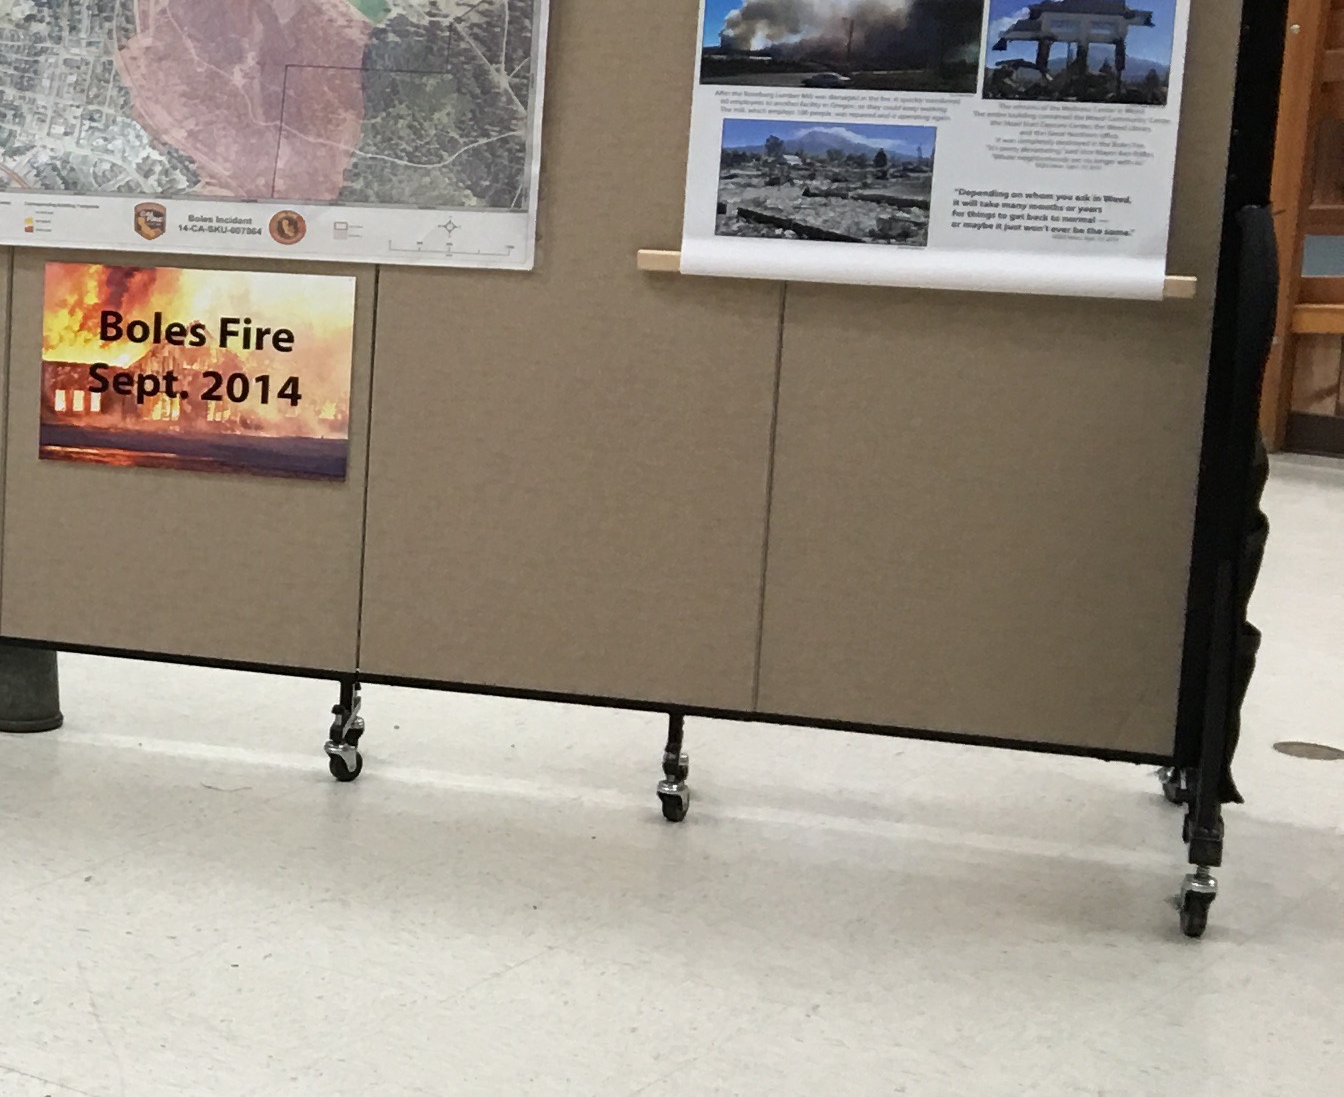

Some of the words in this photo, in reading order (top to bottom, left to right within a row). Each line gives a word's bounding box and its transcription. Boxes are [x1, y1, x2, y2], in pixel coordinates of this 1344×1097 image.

[99, 310, 207, 348] Boles
[219, 317, 295, 352] Fire
[88, 363, 189, 405] Sept.
[201, 371, 302, 406] 2014
